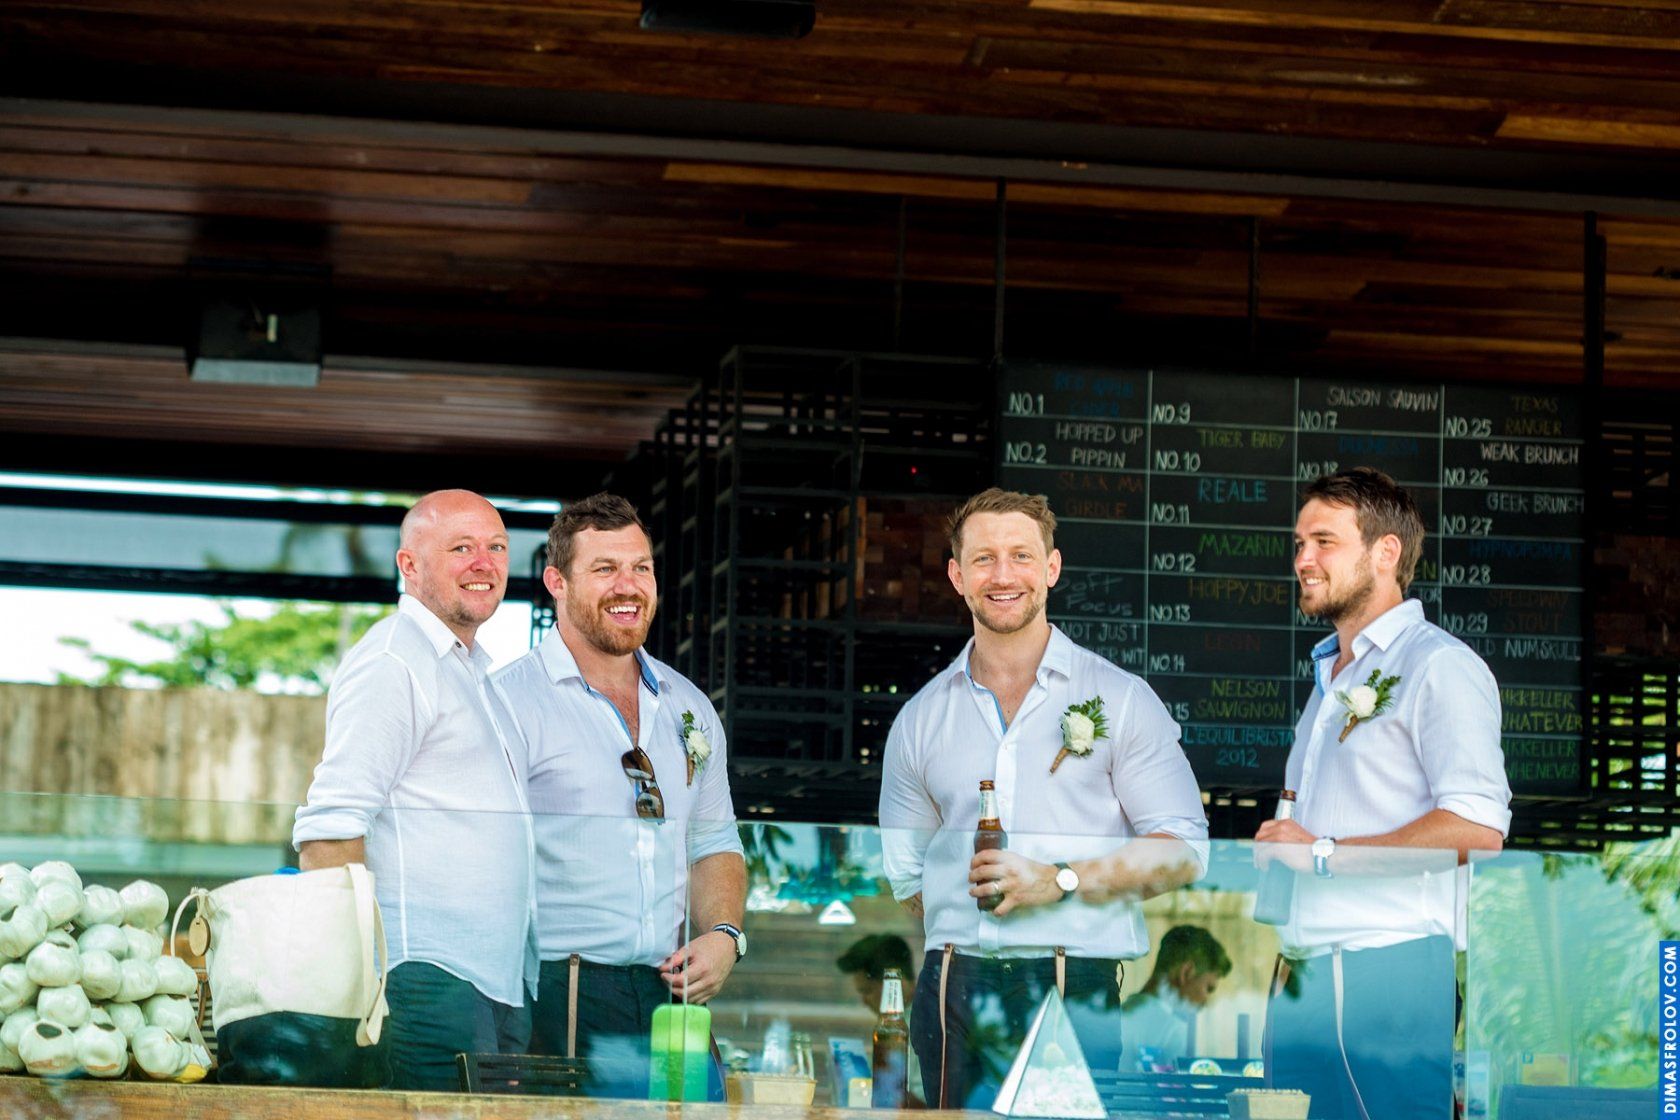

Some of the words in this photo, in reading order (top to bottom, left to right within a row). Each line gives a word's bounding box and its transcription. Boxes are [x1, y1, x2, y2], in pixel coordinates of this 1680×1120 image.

[1328, 386, 1382, 407] SAISON
[1387, 389, 1438, 411] SAUVIN
[1055, 422, 1116, 443] HOPPED
[1121, 426, 1144, 445] UP
[1197, 428, 1244, 448] TIGER
[1005, 441, 1047, 464] NO.2
[1071, 447, 1126, 468] PIPPIN
[1155, 450, 1201, 472] NO.10
[1481, 442, 1519, 463] WEAK
[1525, 445, 1579, 465] BRUNCH
[1198, 477, 1268, 503] REALE
[1486, 492, 1528, 512] GEEK
[1534, 494, 1585, 514] BRUNCH
[1199, 532, 1286, 557] MAZARIN
[1188, 577, 1249, 604] HOPPY
[1251, 581, 1289, 606] JOE
[1060, 620, 1092, 641] NOT
[1098, 623, 1141, 642] JUST
[1210, 678, 1281, 698] NELSON
[1194, 699, 1286, 719] SAUVIGNON
[1216, 748, 1260, 768] 2012
